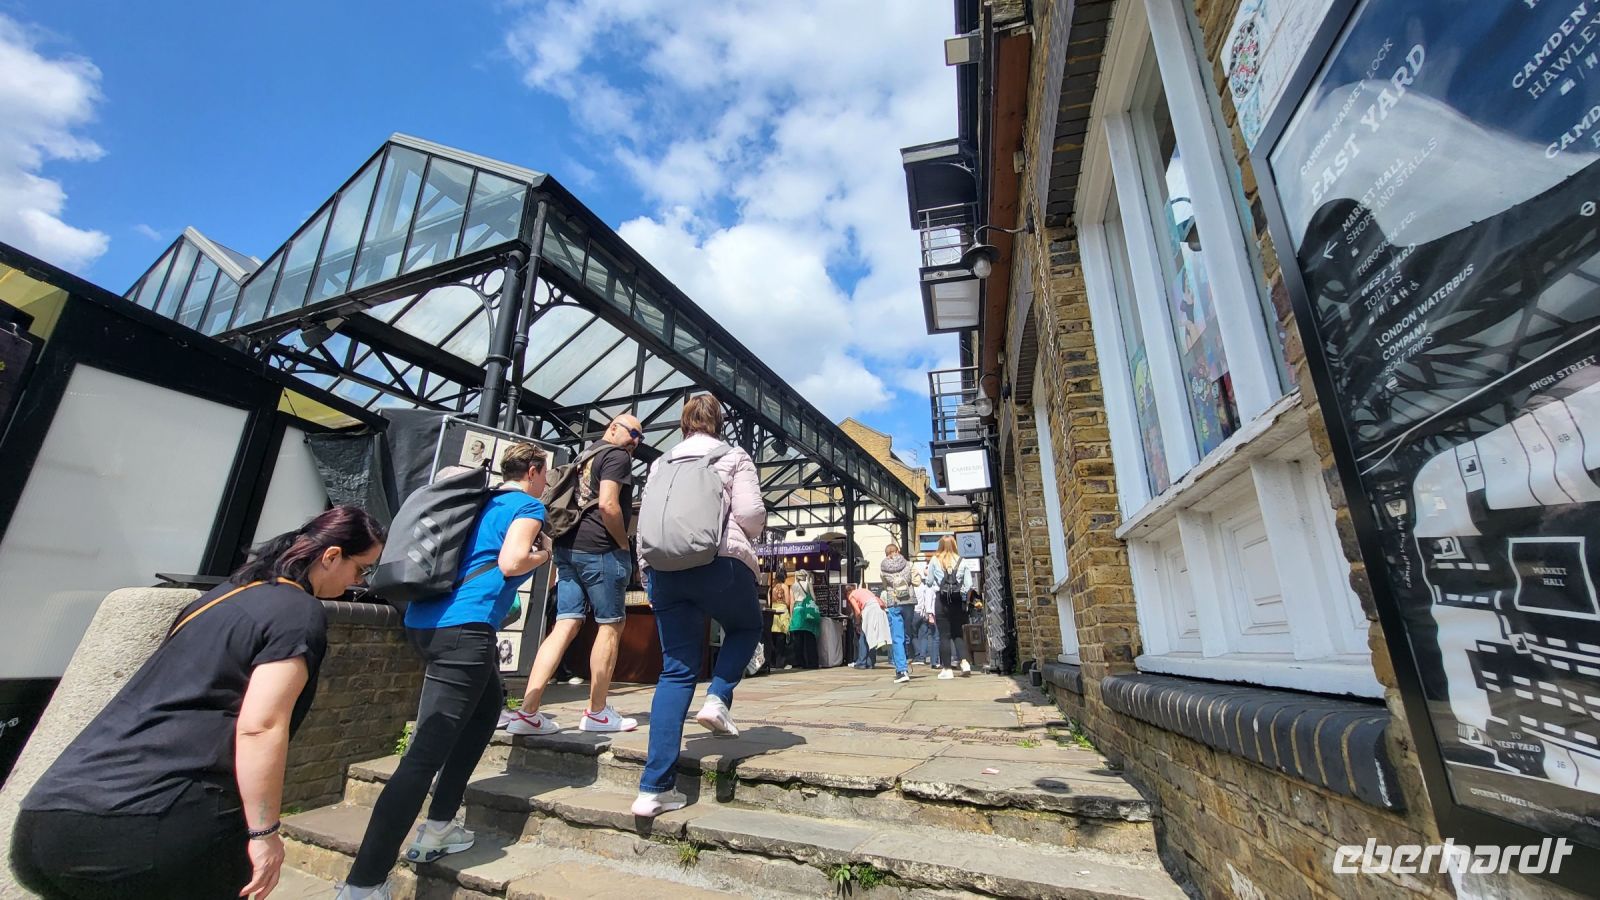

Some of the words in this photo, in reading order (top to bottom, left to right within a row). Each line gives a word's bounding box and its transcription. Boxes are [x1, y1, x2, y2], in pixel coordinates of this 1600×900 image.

[1512, 2, 1588, 89] CAMDEN
[1300, 129, 1332, 176] CAMDEN
[1331, 79, 1366, 132] MARKET
[1366, 38, 1393, 80] LOCK
[1311, 132, 1360, 206] EAST
[1360, 44, 1425, 133] YARD
[1342, 187, 1376, 232] MARKET
[1374, 159, 1405, 191] HALL
[1346, 211, 1377, 245] SHOPS
[1377, 185, 1395, 209] AND
[1395, 137, 1439, 188] STALLS
[1356, 228, 1398, 277] THROUGH
[1361, 268, 1388, 297] WEST
[1389, 242, 1416, 271] YARD
[1363, 271, 1403, 311] TOILETS
[1376, 310, 1417, 347] LONDON
[1417, 263, 1474, 315] WATERBUS
[1382, 319, 1428, 361] COMPANY
[1385, 352, 1406, 376] BOAT
[1407, 332, 1433, 358] TRIPS
[1530, 374, 1556, 391] HIGH
[1555, 355, 1597, 379] STREET
[1532, 567, 1567, 576] MARKET
[1543, 578, 1565, 587] HALL
[1517, 742, 1541, 753] YARD
